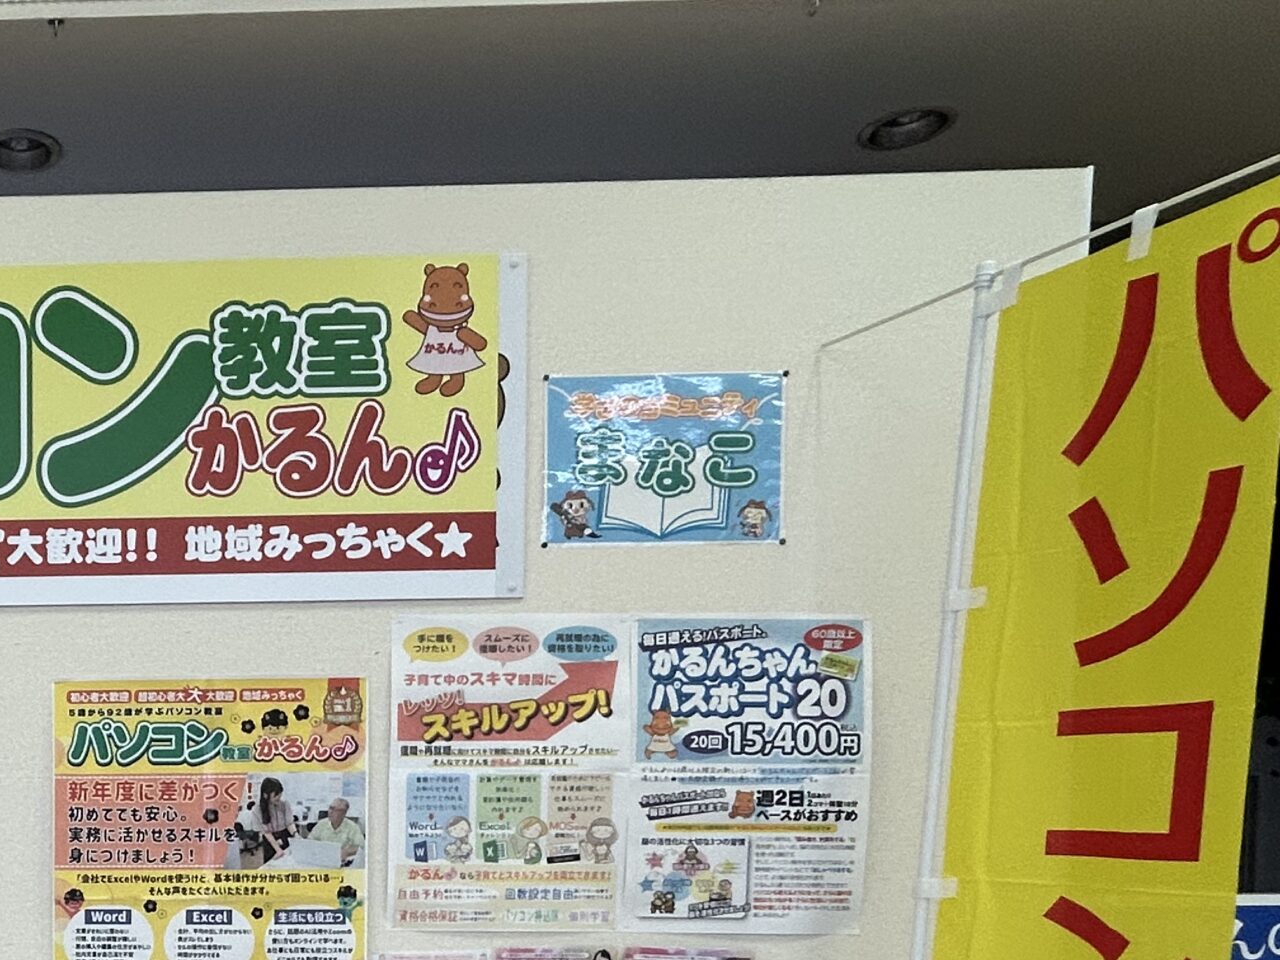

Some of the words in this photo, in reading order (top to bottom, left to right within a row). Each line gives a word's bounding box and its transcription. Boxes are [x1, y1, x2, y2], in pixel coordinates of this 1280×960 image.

[213, 296, 391, 400] 教室
[574, 426, 758, 498] まなこ
[417, 634, 453, 643] 手に職を
[485, 634, 530, 643] スムーズに
[555, 633, 609, 643] 再就職の為に
[810, 629, 857, 639] 60歳以上
[823, 640, 844, 649] 限定
[649, 643, 818, 681] かるんちゃん
[404, 672, 557, 687] 子育て中のスキマ時間に
[422, 688, 613, 743] スキルアップ!
[68, 719, 228, 766] パソコン
[221, 745, 252, 761] 教室
[690, 736, 723, 750] 20回
[728, 721, 861, 756] 15,400円
[756, 789, 804, 807] 週2日
[409, 821, 437, 830] Word
[479, 822, 510, 830] Excel
[68, 827, 236, 844] 実務に活かせるスキルを
[398, 888, 443, 900] 自由予約
[505, 888, 574, 900] 回数設定自由
[90, 911, 126, 923] Word
[192, 911, 228, 923] Excel
[277, 911, 343, 924] 生活にも役立つ
